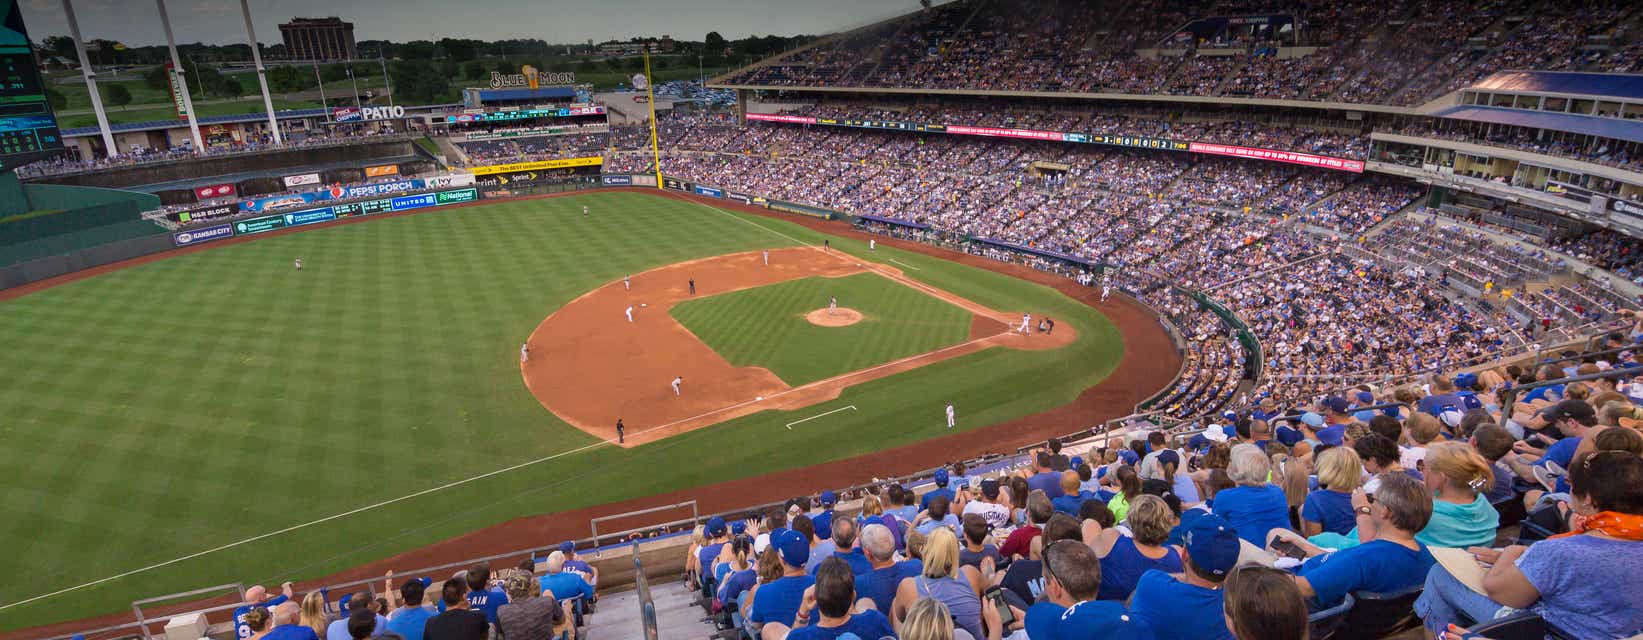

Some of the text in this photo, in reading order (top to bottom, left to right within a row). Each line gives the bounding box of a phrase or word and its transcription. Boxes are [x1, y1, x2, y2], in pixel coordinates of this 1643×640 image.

[490, 71, 575, 89] BLUE MOON
[362, 105, 405, 120] PATIO
[511, 173, 530, 182] Sprint
[349, 181, 412, 197] PEPSI PORCH
[447, 190, 473, 199] National
[395, 199, 425, 207] UNITED
[207, 207, 230, 215] BLOCK
[193, 230, 217, 239] KANSAS
[217, 227, 231, 235] CITY
[470, 595, 489, 605] AIN
